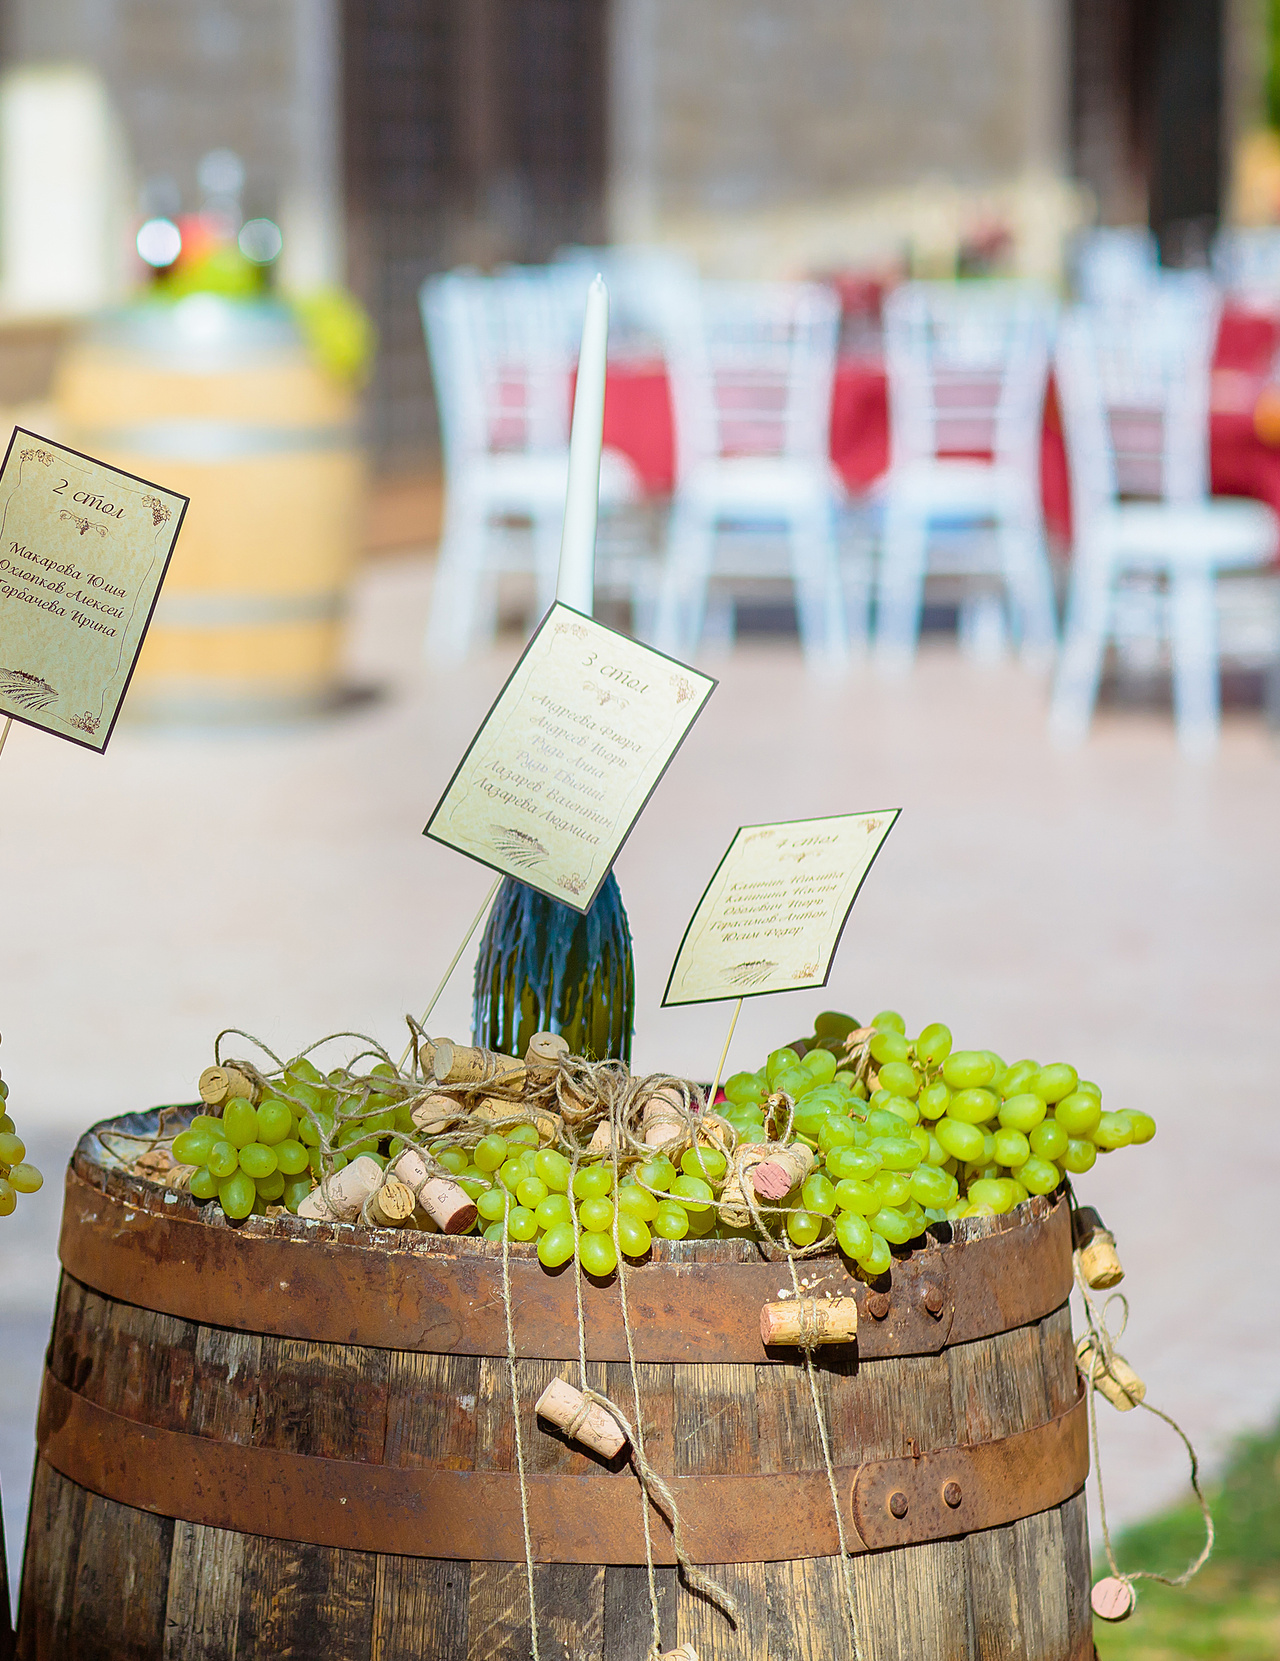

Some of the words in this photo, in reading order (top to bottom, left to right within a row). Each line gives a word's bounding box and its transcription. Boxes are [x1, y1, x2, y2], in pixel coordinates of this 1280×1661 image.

[52, 479, 69, 495] 2
[73, 491, 126, 520] стол
[9, 541, 82, 581] Макарова
[86, 574, 127, 599] Юлия
[65, 589, 125, 620] Алексей
[70, 608, 118, 639] Ирина
[581, 652, 598, 668] 3
[600, 662, 650, 695] стол
[530, 712, 587, 747] Андреев
[590, 742, 628, 769] Игорь
[532, 692, 597, 732] Андреева
[599, 724, 643, 754] Флюра
[516, 750, 549, 776] Рудь
[553, 769, 607, 801] Евгений
[531, 735, 565, 761] Рудь
[566, 754, 605, 780] Анна
[473, 777, 539, 813] Лазарева
[539, 811, 601, 846] Людмила
[484, 760, 546, 793] Лазарев
[546, 783, 615, 828] Валентин
[792, 834, 840, 848] стол
[780, 910, 828, 922] Антон
